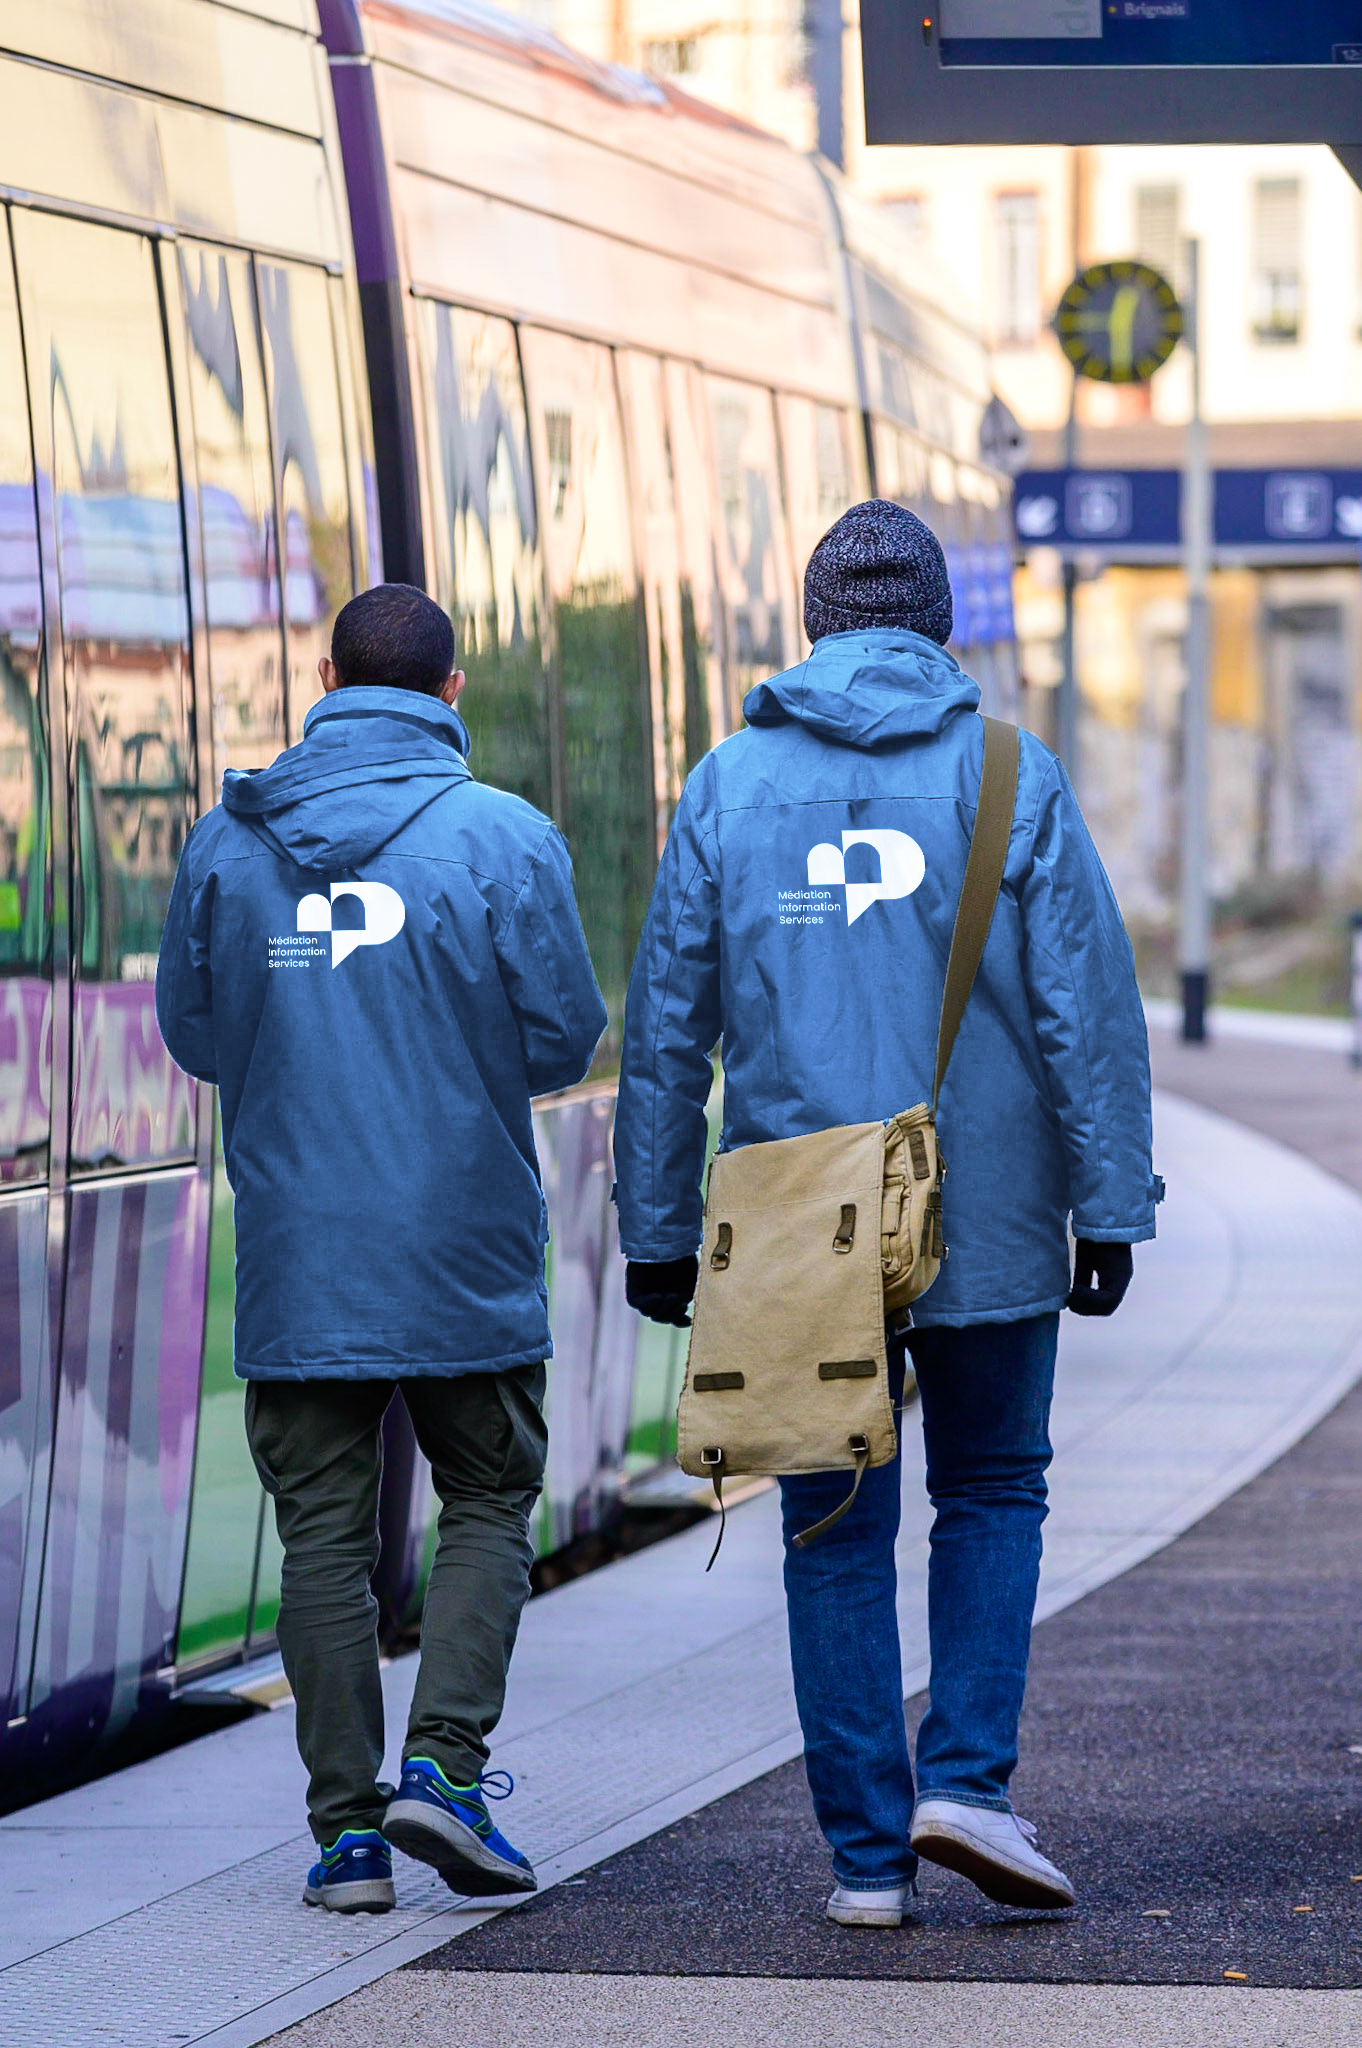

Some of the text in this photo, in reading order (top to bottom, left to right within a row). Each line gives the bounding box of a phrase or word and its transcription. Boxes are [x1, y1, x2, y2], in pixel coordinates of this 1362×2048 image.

[1124, 2, 1186, 19] Brignais
[778, 890, 831, 900] Médiation
[778, 902, 841, 912] Information
[779, 914, 824, 924] Services
[268, 936, 318, 945] Médiation
[268, 947, 326, 957] Information
[268, 959, 310, 968] Services
